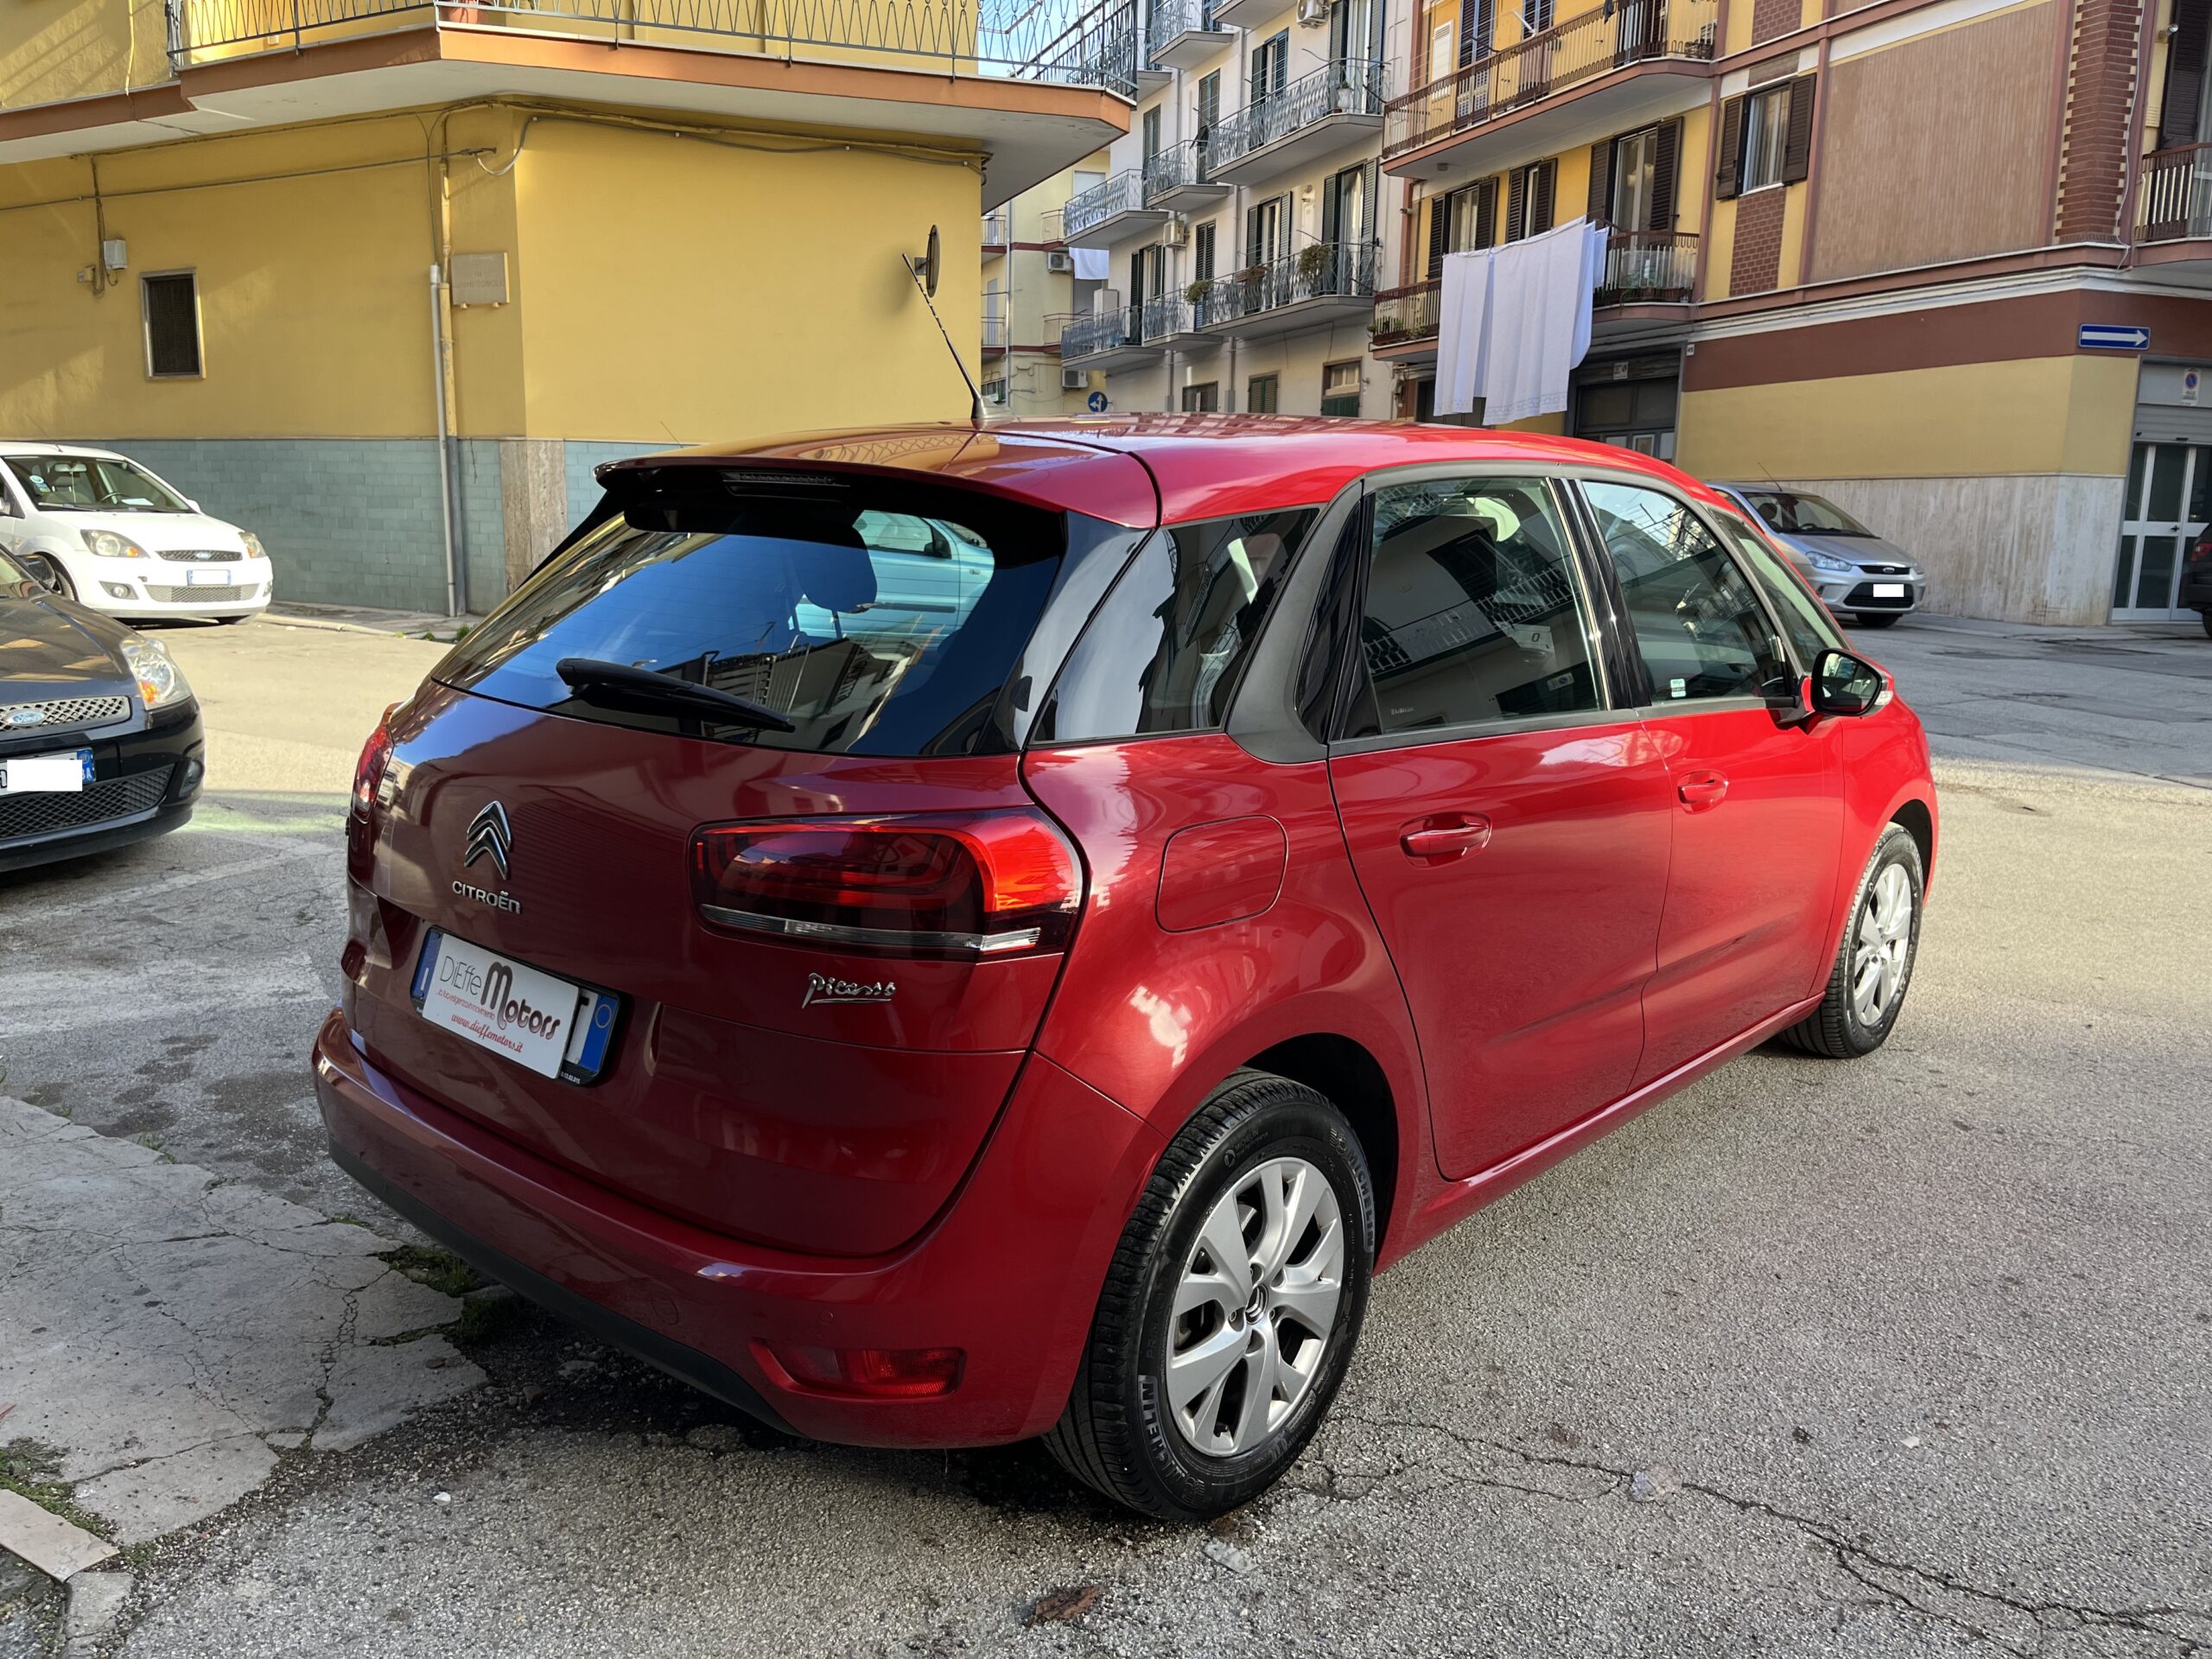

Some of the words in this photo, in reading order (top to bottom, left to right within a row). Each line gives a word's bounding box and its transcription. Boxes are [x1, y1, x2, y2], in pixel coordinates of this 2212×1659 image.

[440, 955, 482, 995] DiEffe
[480, 961, 561, 1040] Motors
[802, 972, 896, 1008] Picasso
[451, 1014, 524, 1053] www.dieffemotors.it
[1348, 1150, 1374, 1247] MICHELIN
